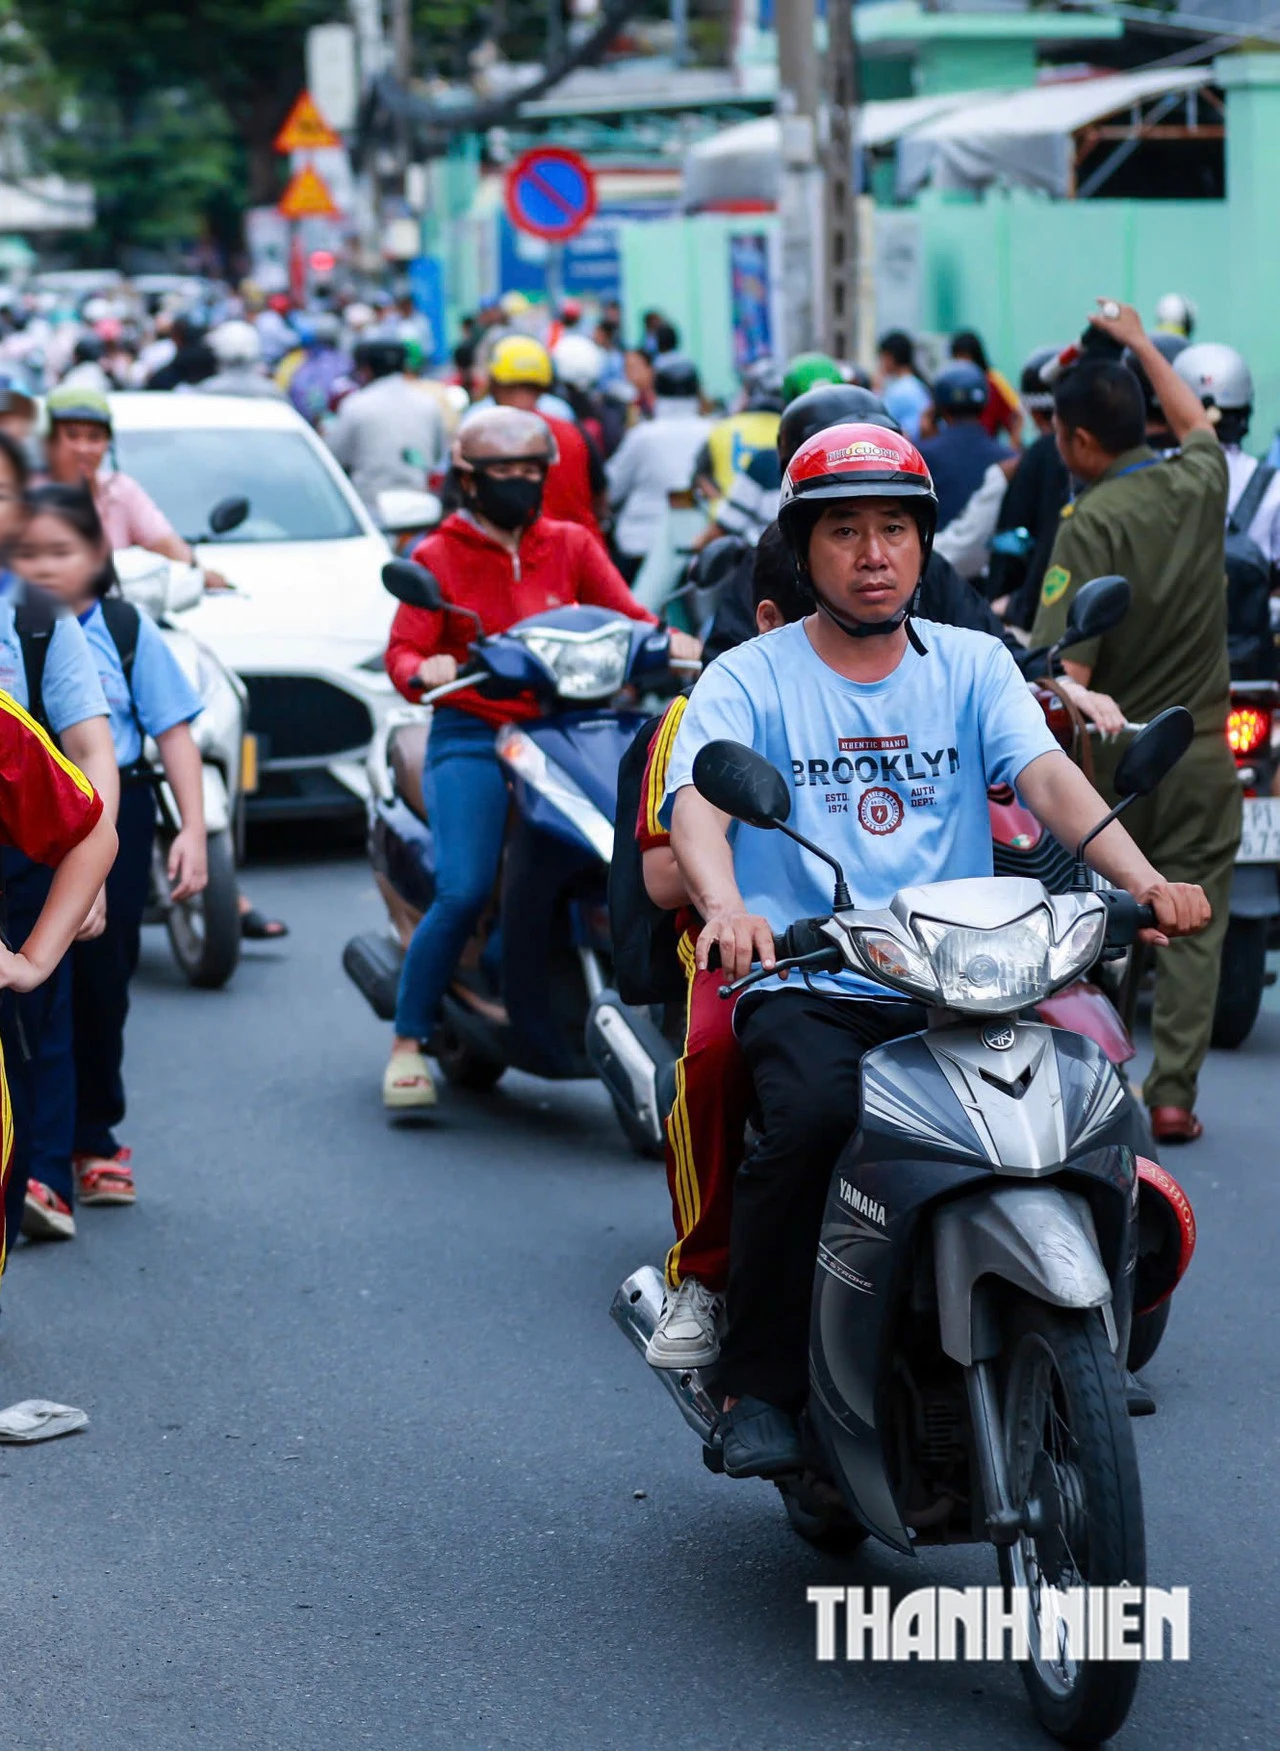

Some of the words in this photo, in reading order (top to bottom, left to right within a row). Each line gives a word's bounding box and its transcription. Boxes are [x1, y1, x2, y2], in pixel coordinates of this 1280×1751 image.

[911, 786, 936, 798] AUTH
[828, 804, 849, 814] 1974
[911, 799, 937, 808] DEPT.
[840, 1177, 887, 1226] YAMAHA
